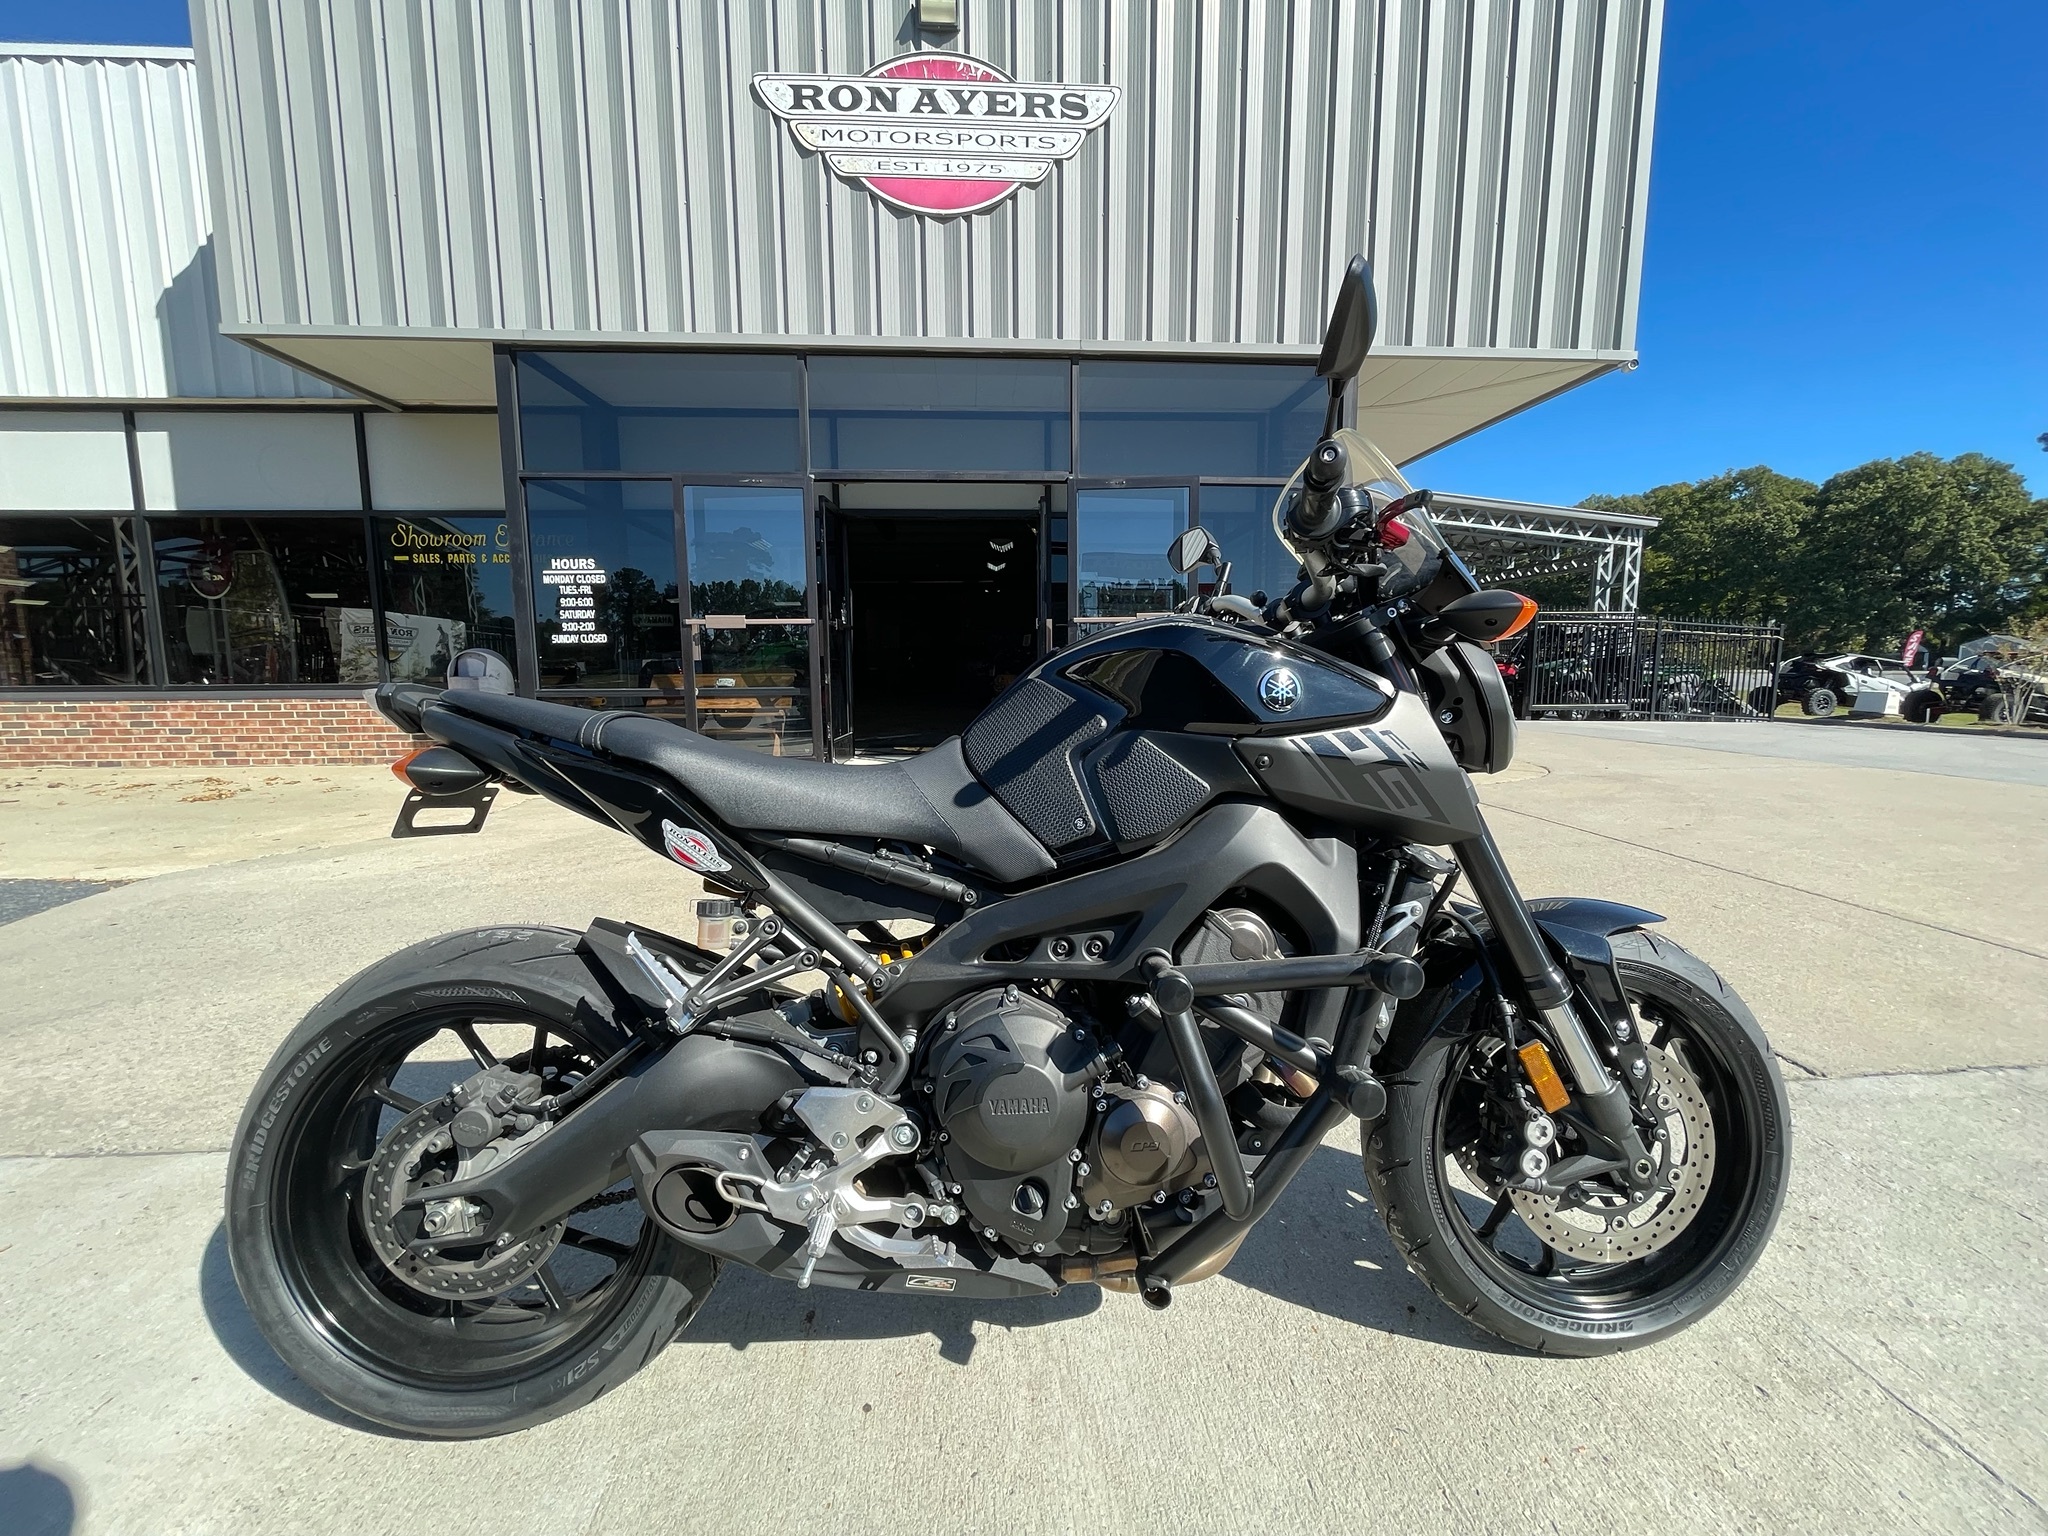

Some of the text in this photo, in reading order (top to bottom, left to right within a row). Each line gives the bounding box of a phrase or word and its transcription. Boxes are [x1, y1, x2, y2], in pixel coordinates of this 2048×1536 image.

[786, 84, 1089, 121] RON AYERS
[821, 129, 1056, 150] MOTORSPORTS
[877, 160, 1003, 175] EST. 1975
[390, 523, 486, 549] Showroom
[412, 553, 444, 564] SALES,
[447, 553, 476, 563] PARTS
[481, 553, 487, 563] &
[551, 558, 596, 569] HOURS
[542, 574, 606, 584] MONDAY CLOSED
[559, 609, 596, 619] SATURDAY
[551, 633, 608, 644] SUNDAY CLOSED
[668, 828, 690, 845] RON
[242, 1036, 333, 1190] BRIDGESTONE
[988, 1096, 1050, 1116] YAMAHA
[1500, 1293, 1634, 1333] BRIDGESTONE
